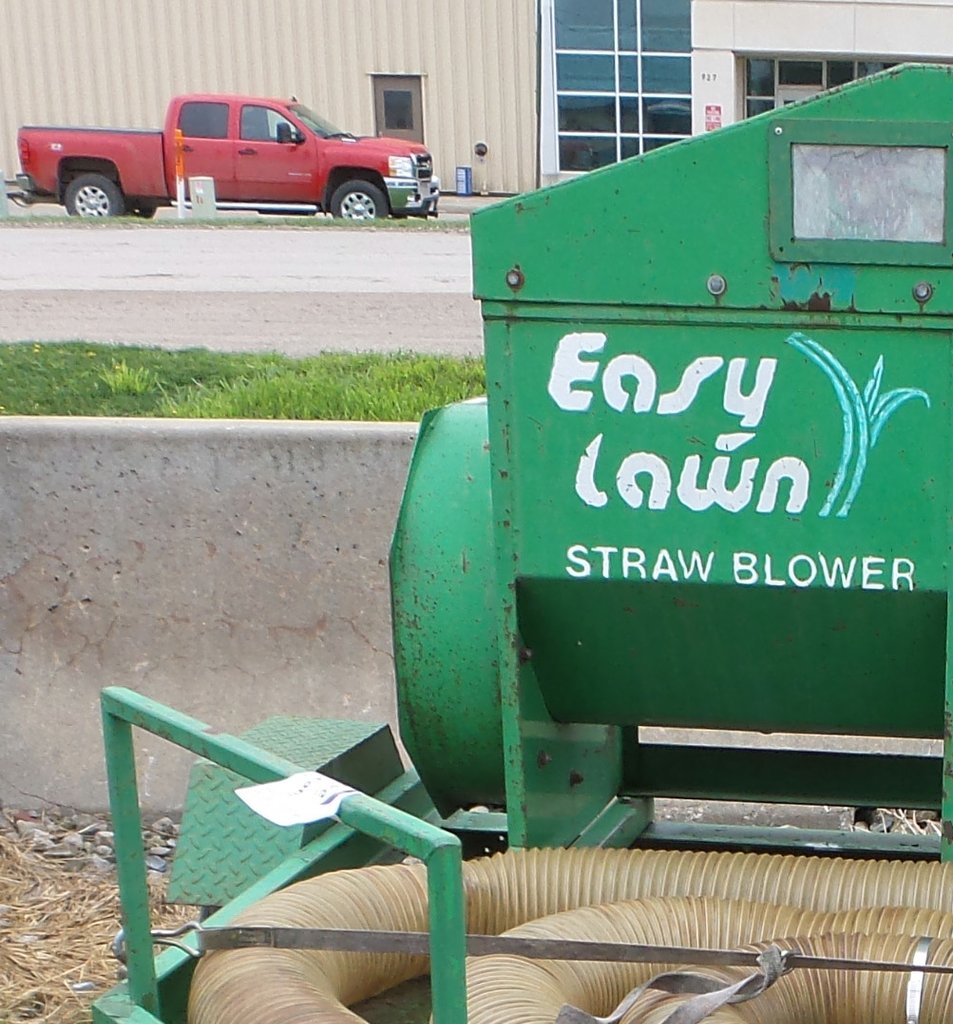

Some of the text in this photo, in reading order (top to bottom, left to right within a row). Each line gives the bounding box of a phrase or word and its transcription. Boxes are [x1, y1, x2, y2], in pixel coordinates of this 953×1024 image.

[547, 331, 778, 450] Easy
[565, 544, 916, 592] STRAW BLOWER
